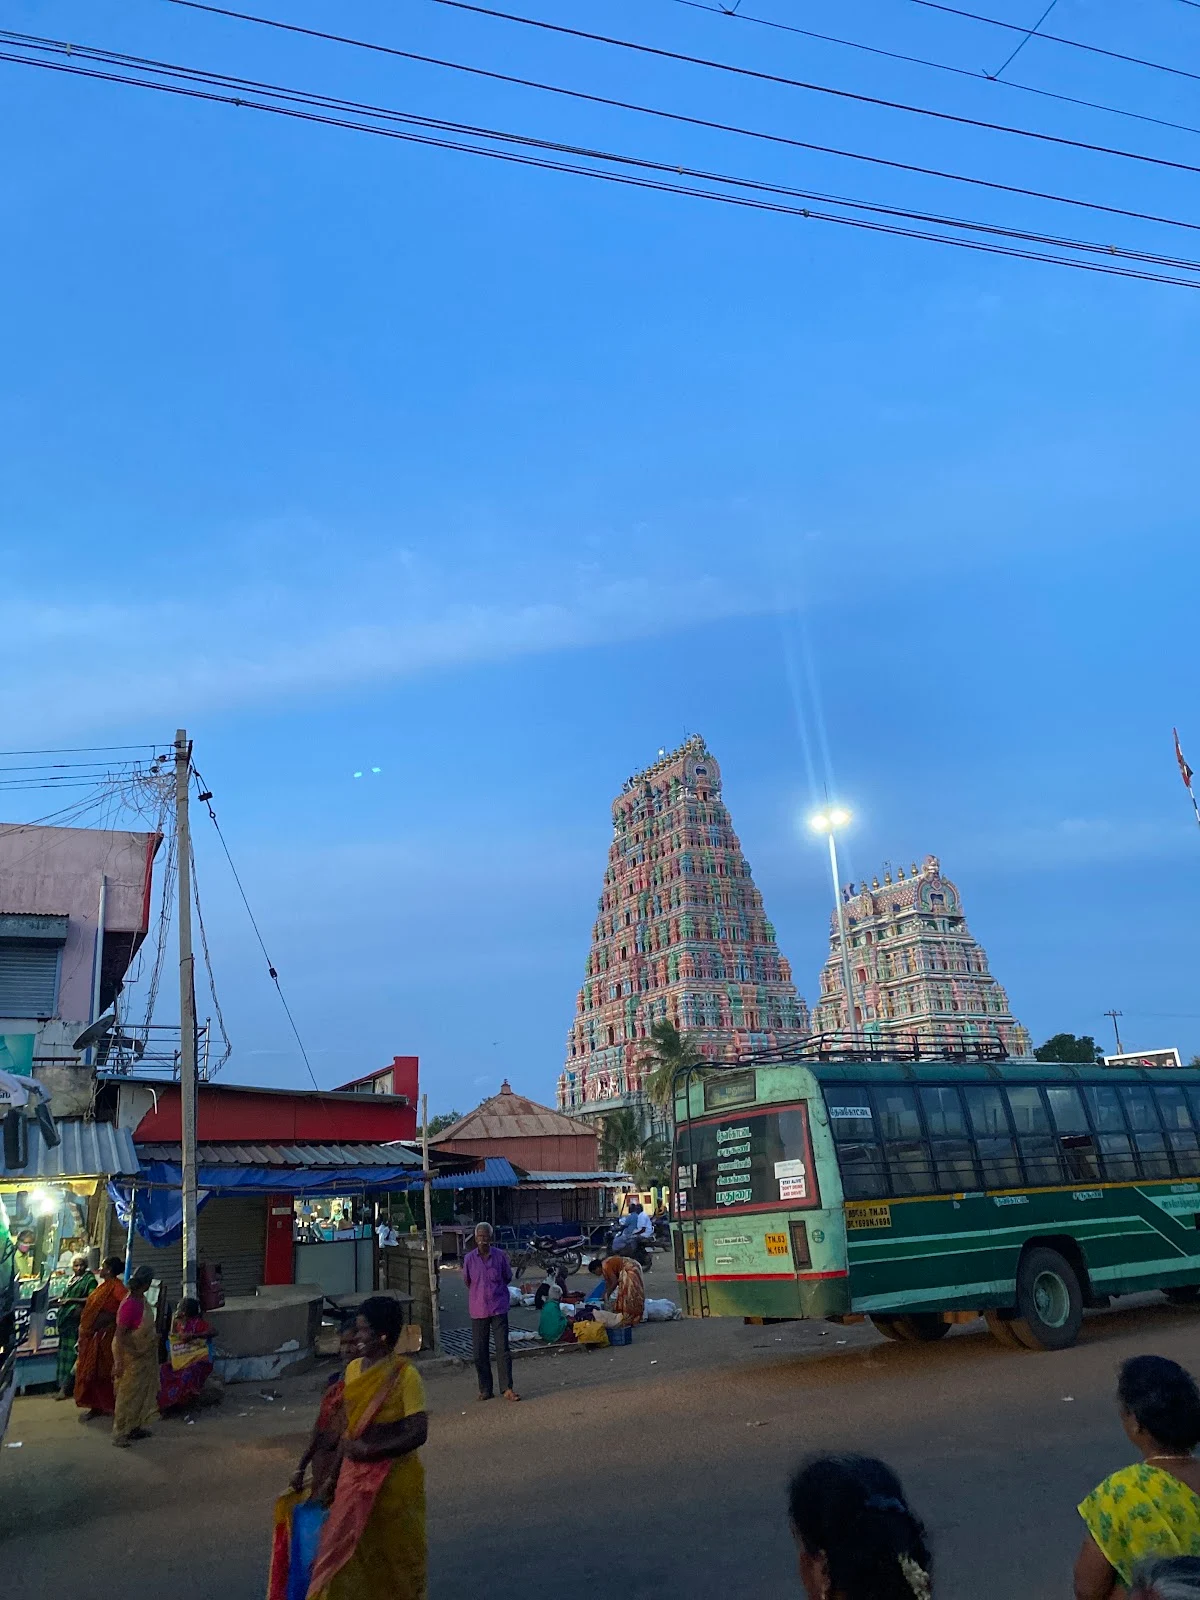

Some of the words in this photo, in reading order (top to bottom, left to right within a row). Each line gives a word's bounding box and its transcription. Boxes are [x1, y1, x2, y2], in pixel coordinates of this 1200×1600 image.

[716, 1189, 752, 1205] மதுரை
[869, 1207, 887, 1216] TN.63
[768, 1235, 785, 1244] TN.63
[768, 1245, 788, 1254] N.1698
